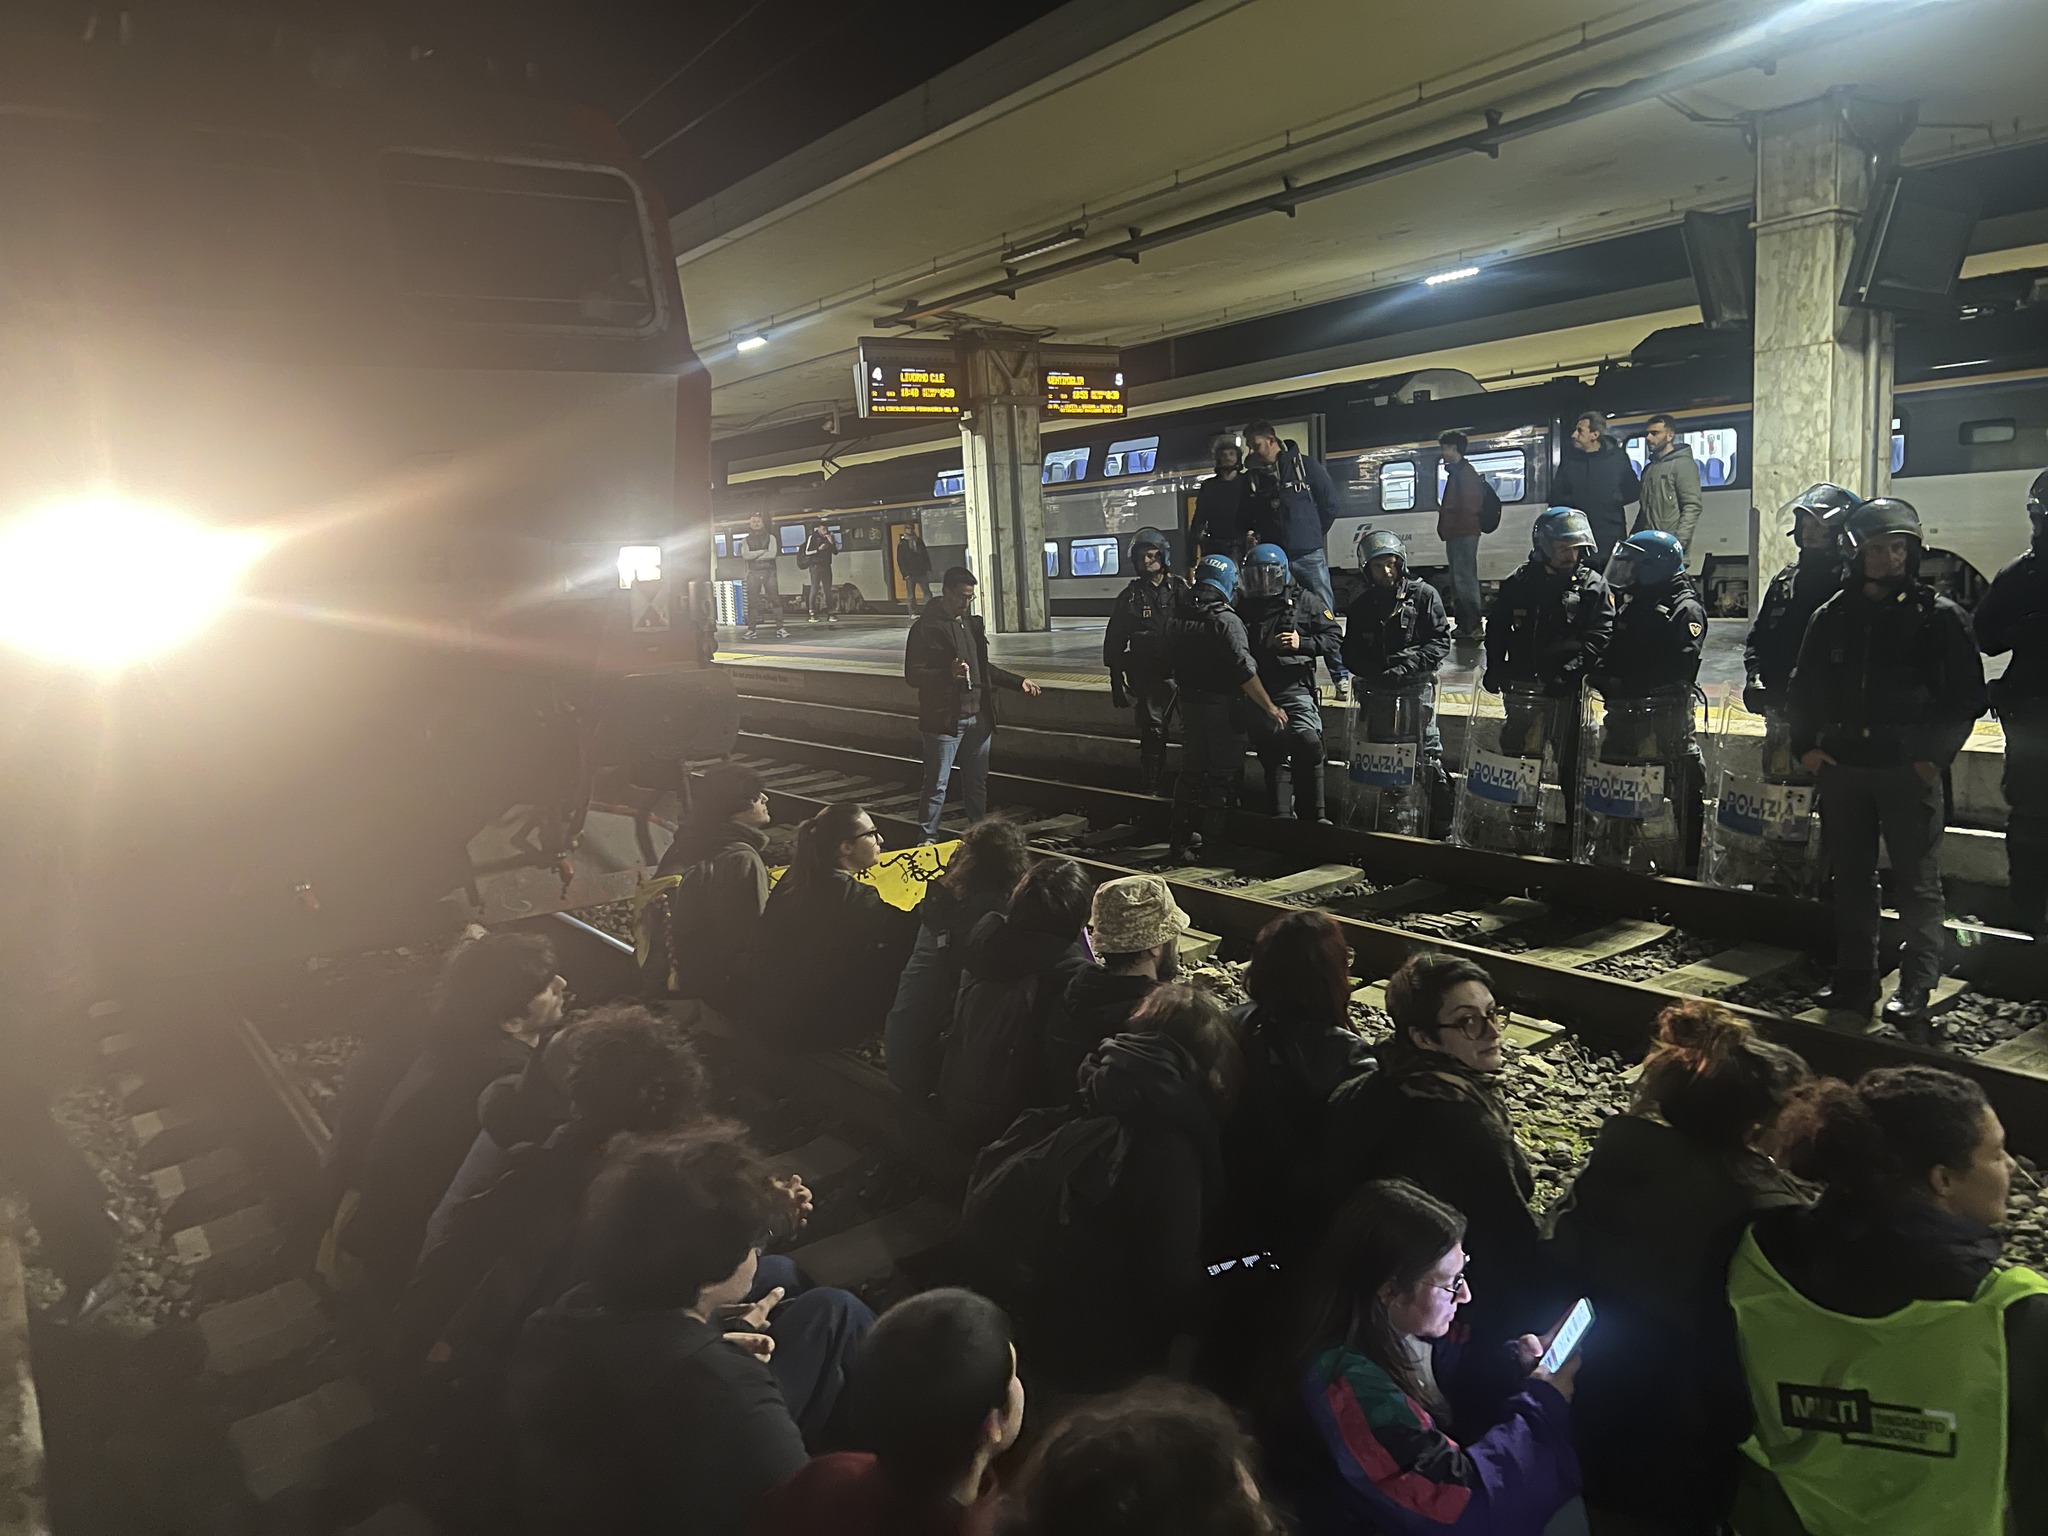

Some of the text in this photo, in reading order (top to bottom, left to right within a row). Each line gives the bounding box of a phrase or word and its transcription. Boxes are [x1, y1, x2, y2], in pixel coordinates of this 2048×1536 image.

[872, 367, 882, 381] 4
[900, 372, 929, 383] LIVORNO
[1115, 373, 1123, 386] 5
[1355, 753, 1405, 775] POLIZIA
[1474, 761, 1528, 792] POLIZIA
[1591, 776, 1651, 802] POLIZIA
[1726, 791, 1796, 826] POLIZIA
